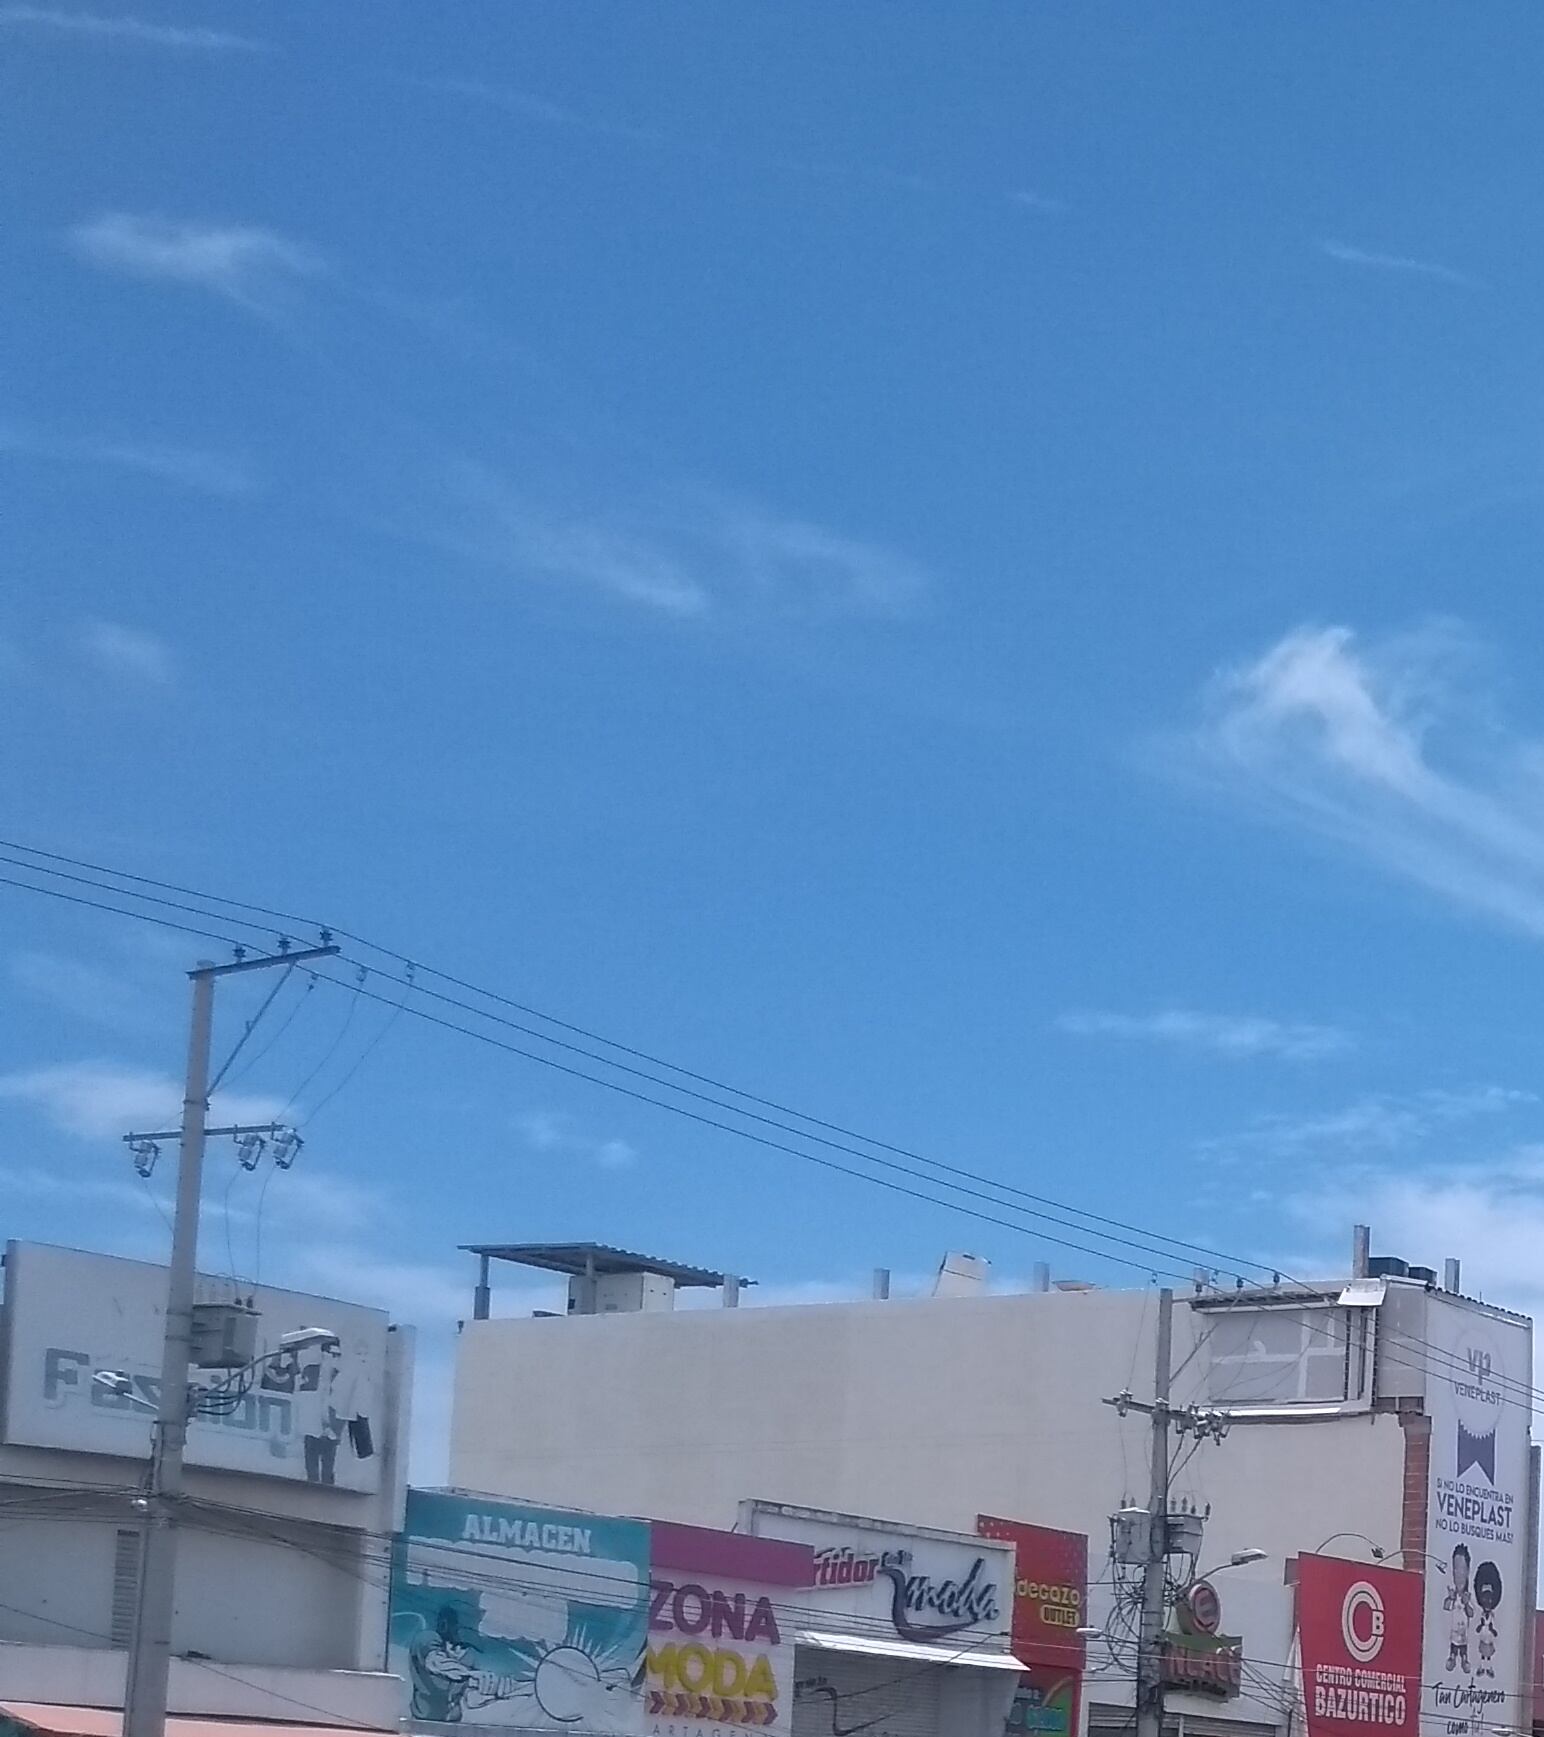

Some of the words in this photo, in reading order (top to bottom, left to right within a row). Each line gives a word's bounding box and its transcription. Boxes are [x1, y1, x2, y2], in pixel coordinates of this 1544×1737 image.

[44, 1347, 292, 1435] Fasion
[1454, 1381, 1501, 1406] VENEPLAST
[1436, 1491, 1513, 1528] VENEPLAST
[1466, 1483, 1504, 1504] ENCUENTRA
[462, 1513, 592, 1554] ALMACEN
[1435, 1518, 1448, 1531] NO
[1449, 1520, 1460, 1534] LO
[1461, 1523, 1494, 1541] BUSQUES
[648, 1579, 781, 1645] ZONA
[1043, 1606, 1078, 1626] OUTLET
[647, 1641, 779, 1701] MODA
[1315, 1663, 1353, 1686] CENTRO
[1354, 1668, 1406, 1694] COMERCIAL
[1314, 1685, 1406, 1726] BAZURTICO
[1432, 1681, 1451, 1707] Tan
[1453, 1677, 1505, 1714] Cartagenero
